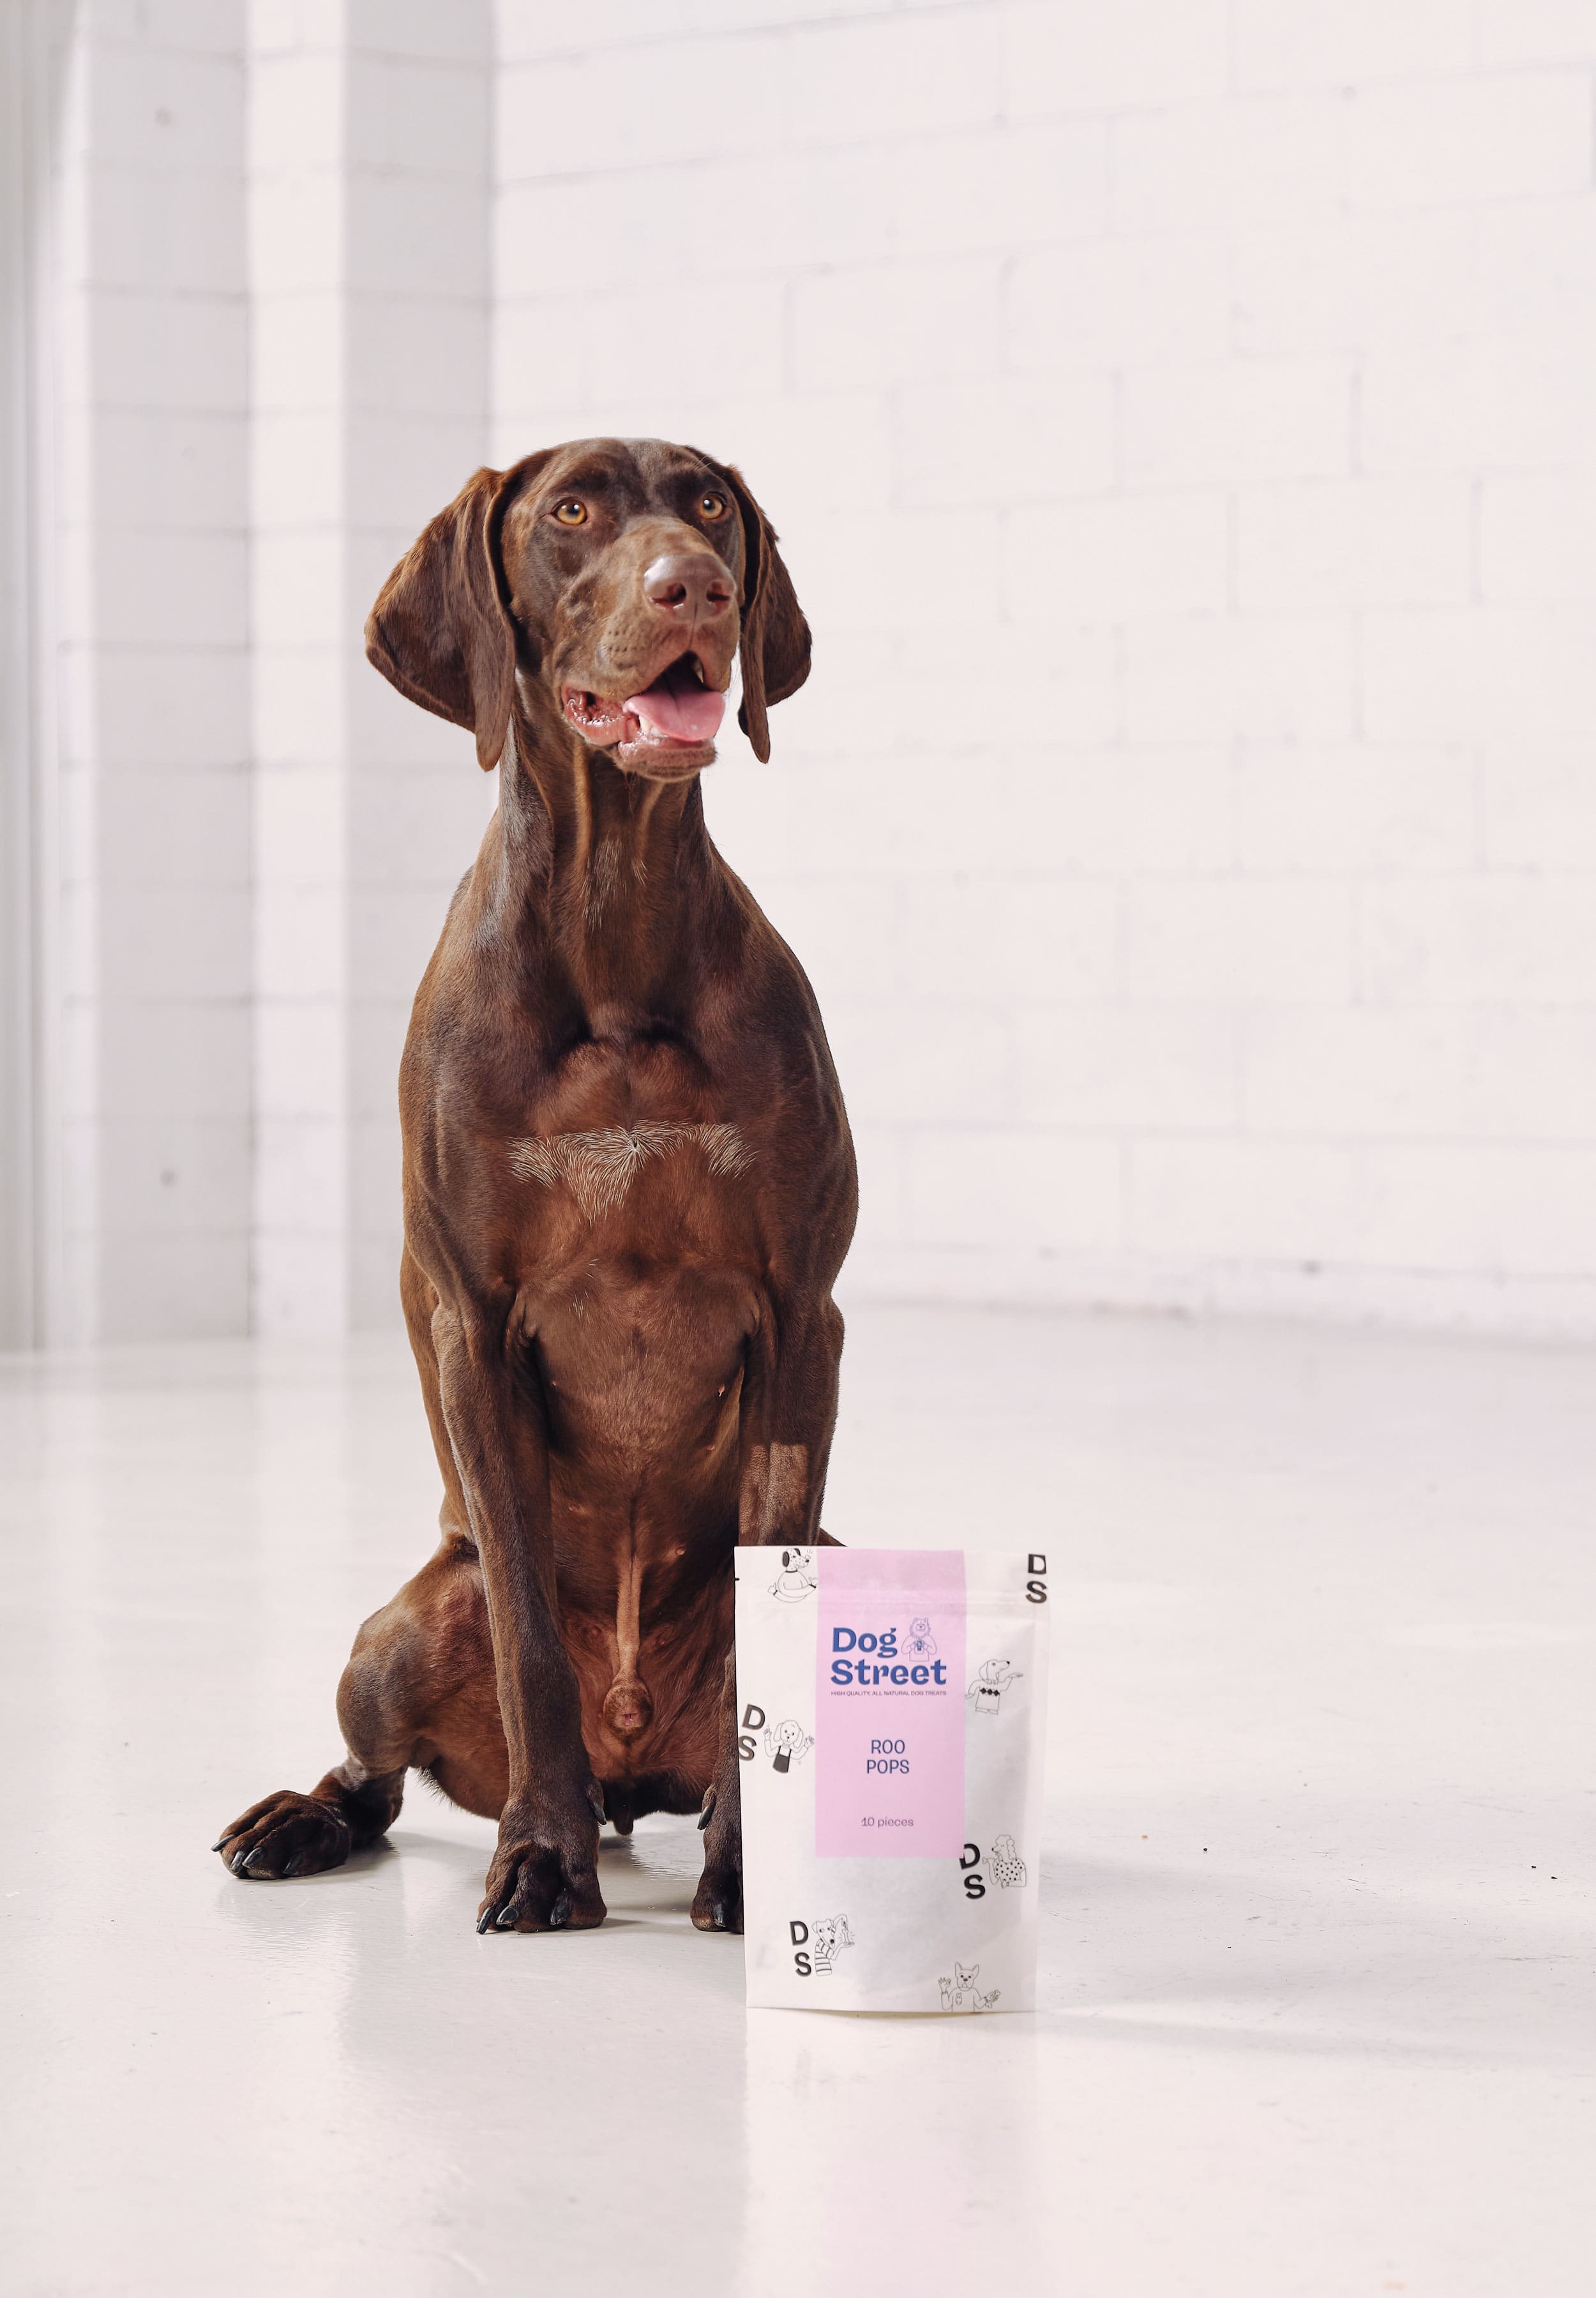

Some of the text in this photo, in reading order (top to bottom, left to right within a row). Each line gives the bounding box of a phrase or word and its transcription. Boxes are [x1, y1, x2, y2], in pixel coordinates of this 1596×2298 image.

[1025, 1580, 1048, 1604] S
[832, 1627, 898, 1658] Dog
[831, 1659, 947, 1685] Street
[742, 1704, 765, 1730] D
[871, 1739, 905, 1754] ROO
[866, 1759, 910, 1774] POPS
[861, 1817, 914, 1828] 10 pieces
[964, 1874, 986, 1900] S
[790, 1921, 809, 1946] D
[794, 1951, 811, 1977] S
